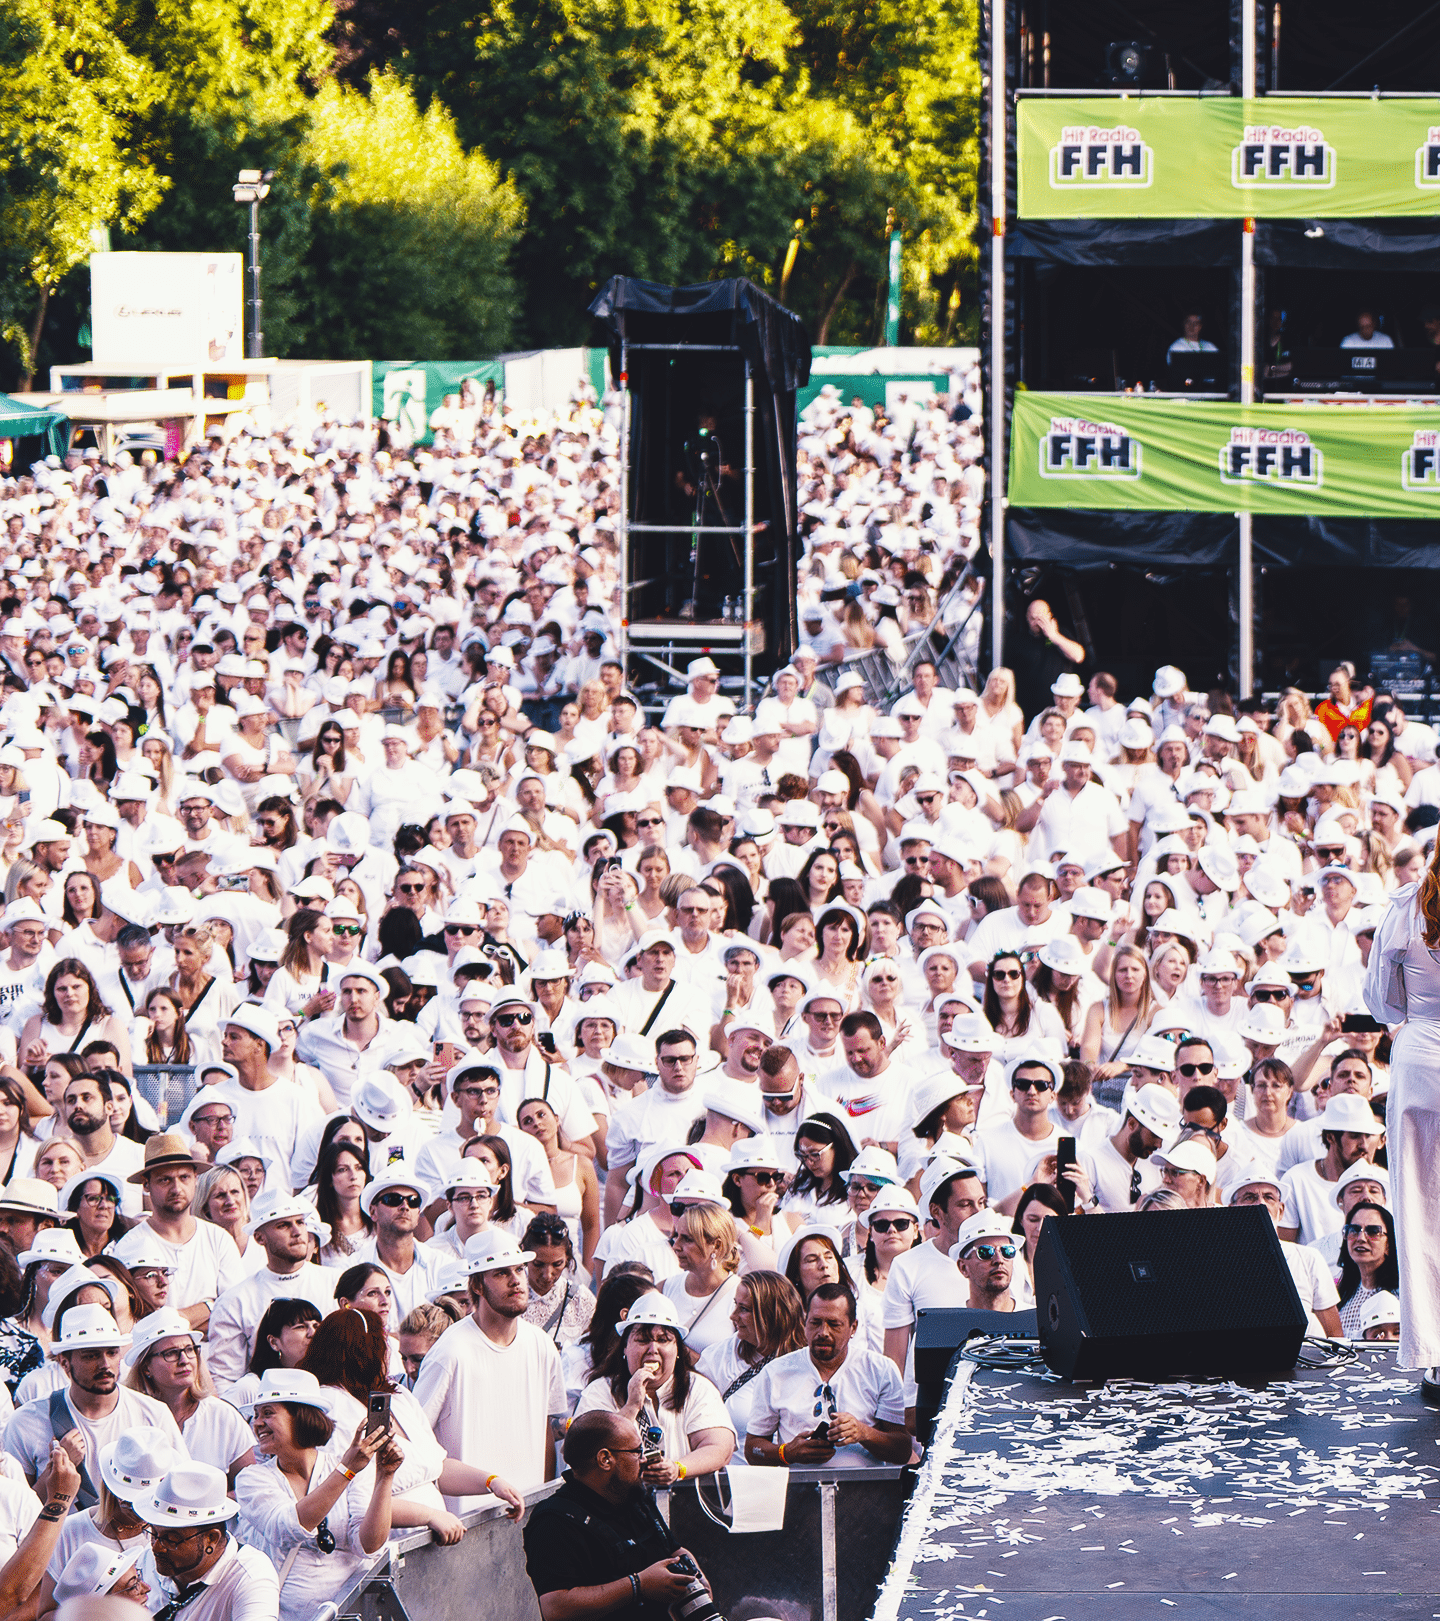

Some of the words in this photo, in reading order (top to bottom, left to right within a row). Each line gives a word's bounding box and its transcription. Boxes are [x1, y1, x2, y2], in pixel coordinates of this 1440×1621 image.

[1064, 129, 1085, 142] Hit
[1089, 128, 1137, 142] Radio
[1247, 129, 1267, 142] Hit
[1271, 128, 1319, 142] Radio
[1062, 145, 1141, 175] FFH
[1244, 145, 1324, 175] FFH
[1052, 420, 1073, 433] Hit
[1233, 430, 1254, 443] Hit
[1258, 429, 1306, 444] Radio
[1416, 433, 1437, 446] Hit
[1051, 436, 1130, 467] FFH
[1231, 446, 1311, 476] FFH
